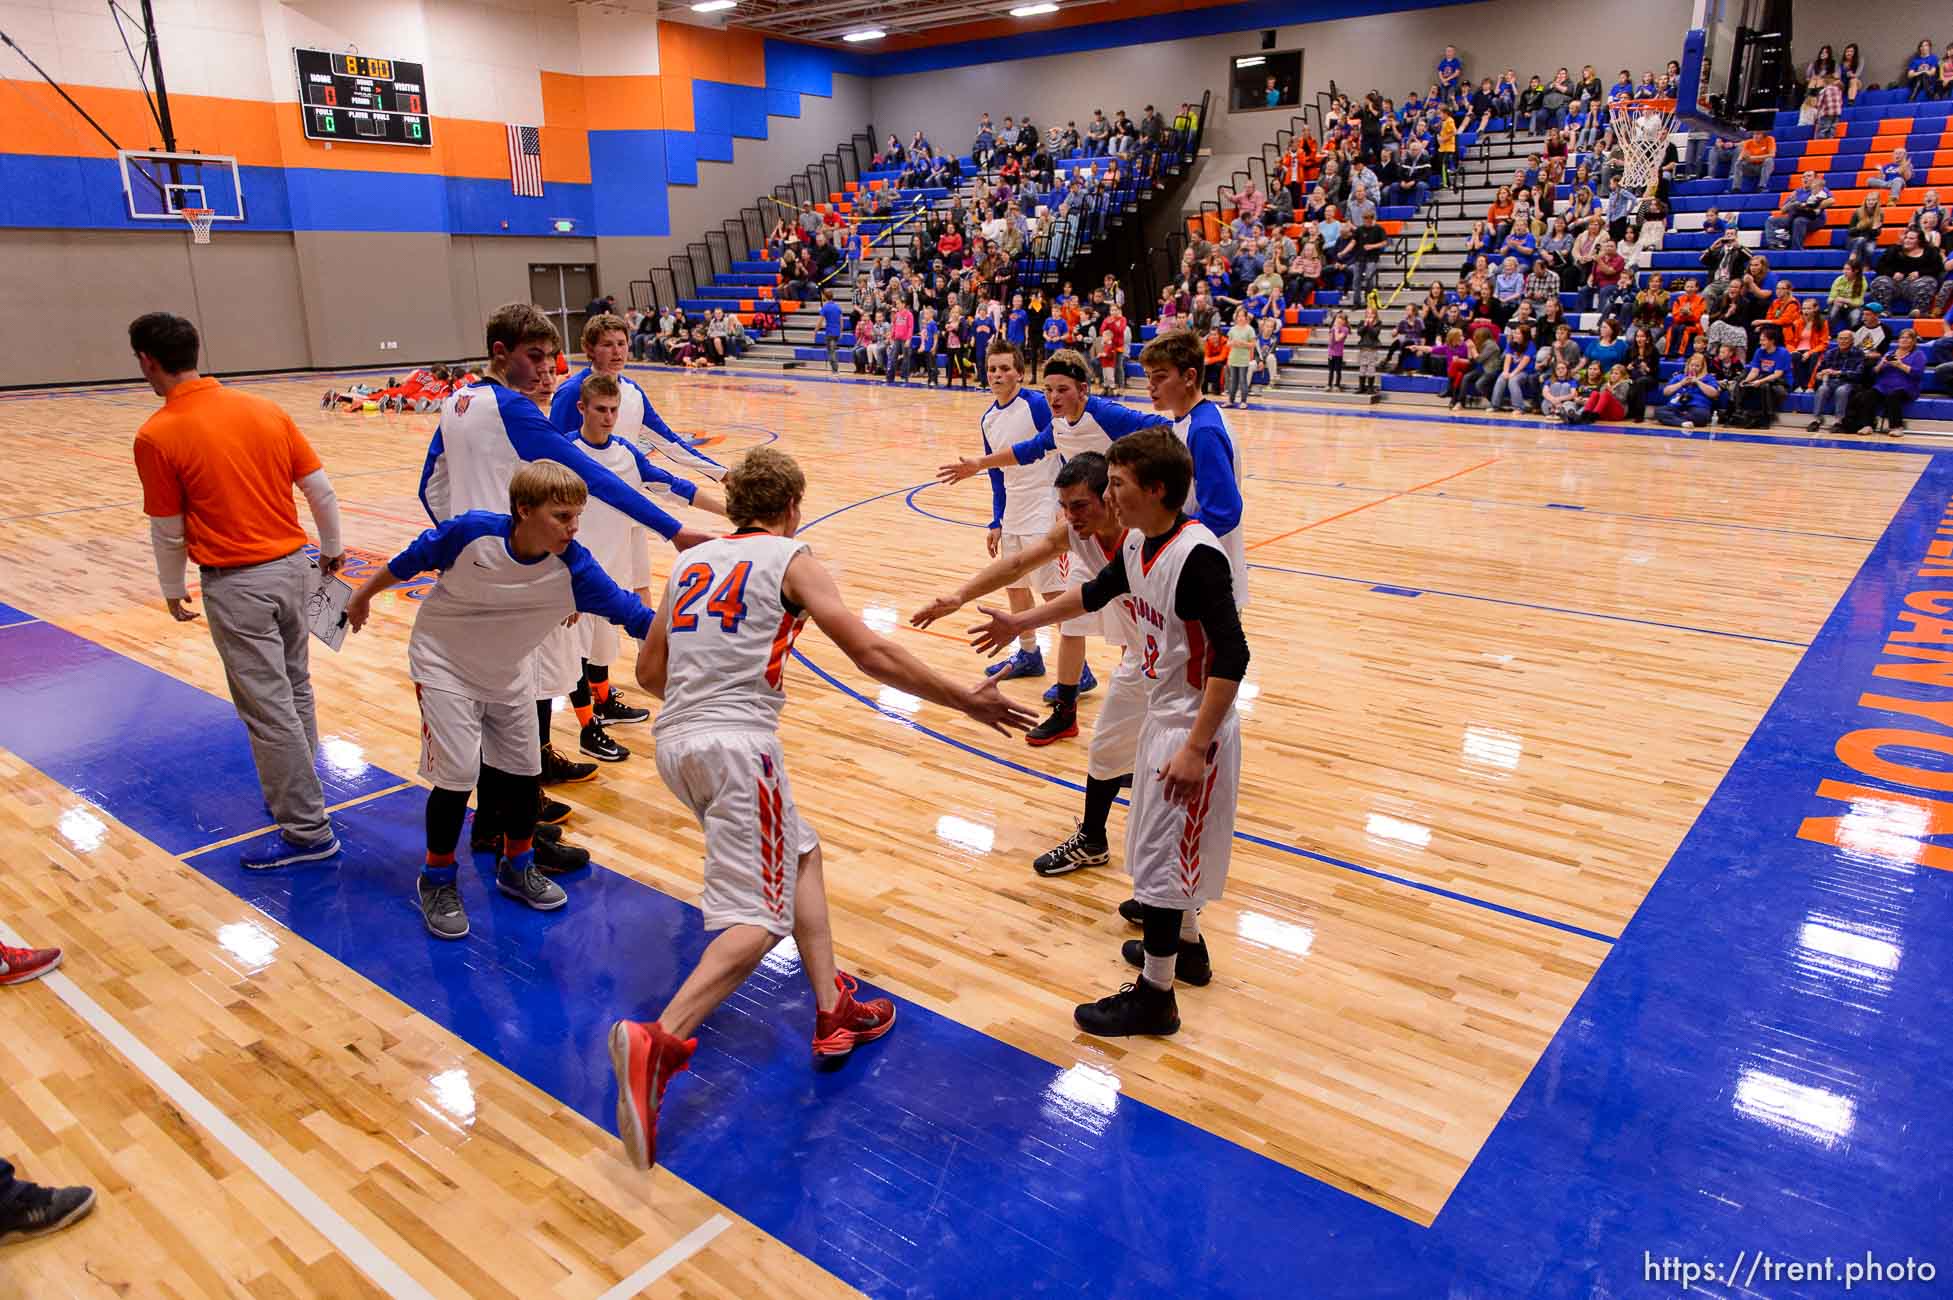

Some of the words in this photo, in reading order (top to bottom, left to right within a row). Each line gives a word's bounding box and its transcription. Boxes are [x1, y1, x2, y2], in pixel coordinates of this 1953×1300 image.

[346, 55, 390, 78] 8:00
[310, 74, 332, 83] HOME
[394, 83, 420, 93] VISITOR
[377, 95, 383, 111] 1
[409, 94, 421, 114] 0
[315, 108, 334, 116] FOULS
[348, 111, 369, 119] PLAYER
[325, 116, 336, 132] 0
[413, 123, 422, 138] 0
[671, 561, 753, 633] 24
